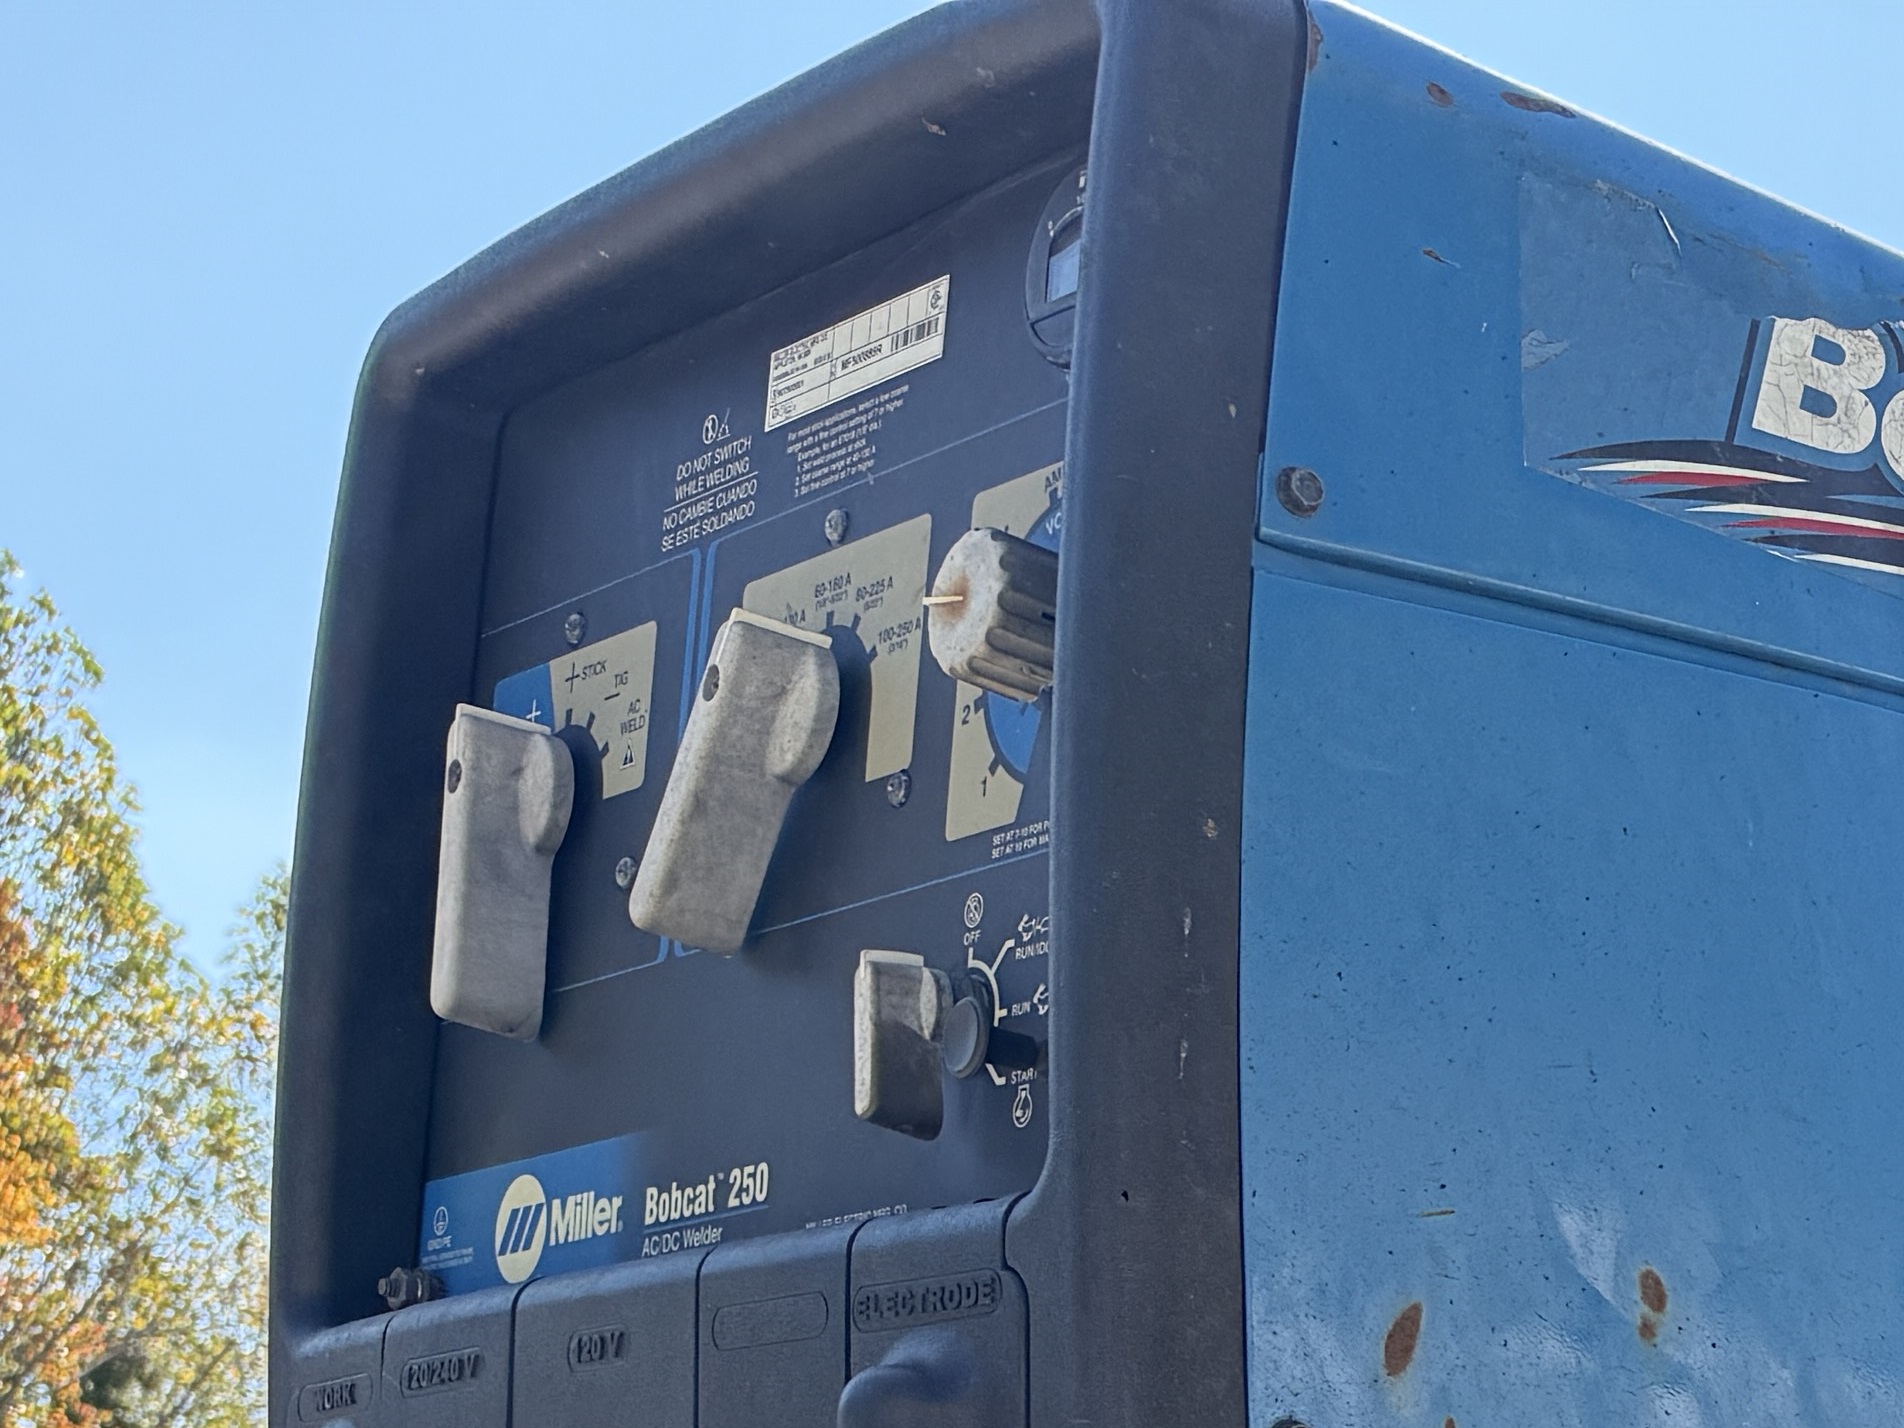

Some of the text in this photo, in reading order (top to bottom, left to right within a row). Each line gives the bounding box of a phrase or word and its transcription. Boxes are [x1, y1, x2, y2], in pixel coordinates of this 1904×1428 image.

[676, 435, 752, 481] DO NOT SWITCH
[674, 456, 750, 501] WHILE WELDING
[663, 479, 757, 531] NO CAMBIE CUANDO
[661, 532, 675, 552] SE
[701, 500, 756, 536] SOLDANDO
[581, 660, 608, 681] STICK
[614, 671, 629, 689] TIG
[627, 699, 641, 716] AC
[961, 704, 971, 726] 2
[620, 714, 646, 735] WELD
[981, 776, 988, 798] 1
[963, 929, 982, 946] OFF
[1011, 1001, 1031, 1017] RUN
[644, 1162, 770, 1226] Bobcat 250
[549, 1190, 623, 1247] Miller
[682, 1225, 724, 1250] Welder
[857, 1276, 997, 1321] ELECTRODE
[314, 1382, 358, 1412] WORK
